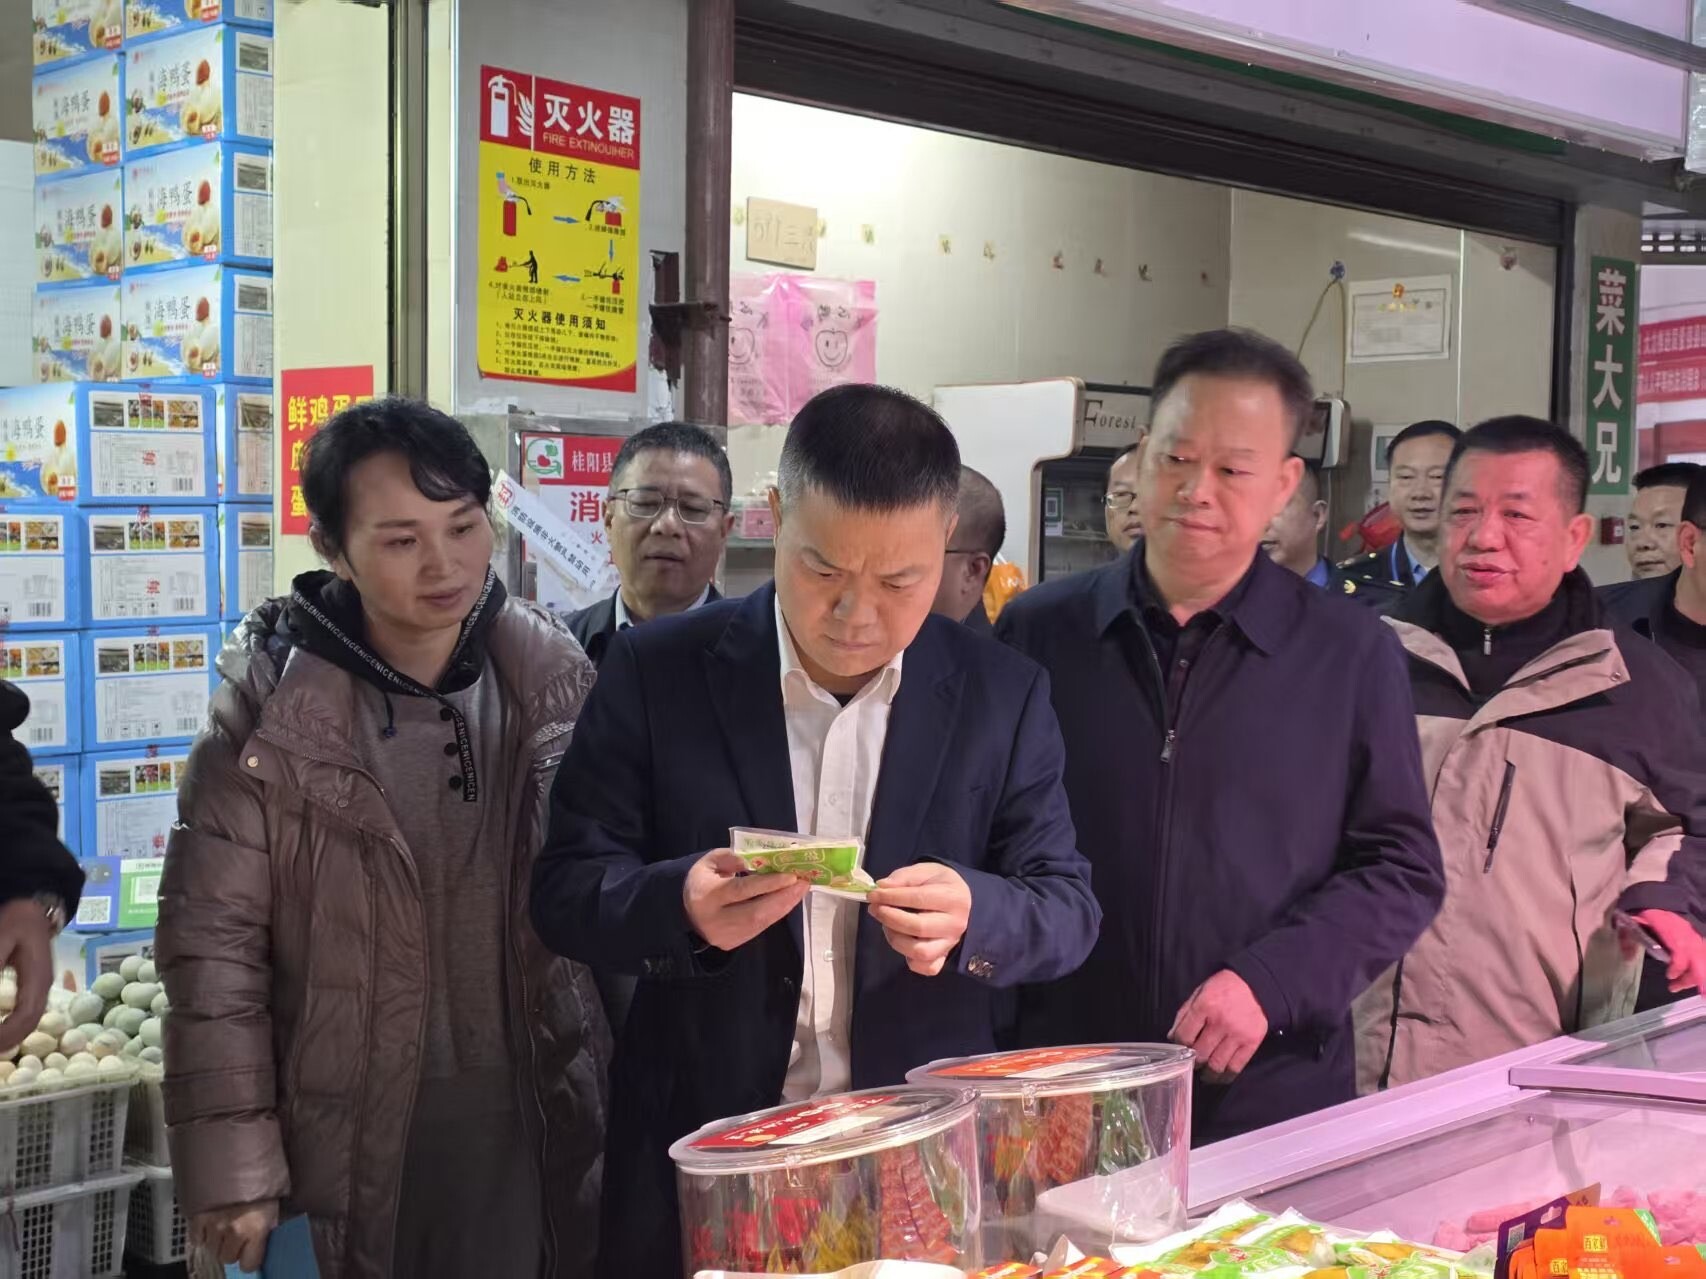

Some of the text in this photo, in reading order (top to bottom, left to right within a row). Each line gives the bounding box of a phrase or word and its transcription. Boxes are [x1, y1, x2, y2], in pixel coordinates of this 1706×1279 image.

[543, 93, 635, 146] 灭火器
[542, 132, 567, 147] FIRE
[529, 157, 597, 185] 使用方法
[513, 307, 606, 330] 灭火器使用须知
[1592, 268, 1627, 484] 菜大兄
